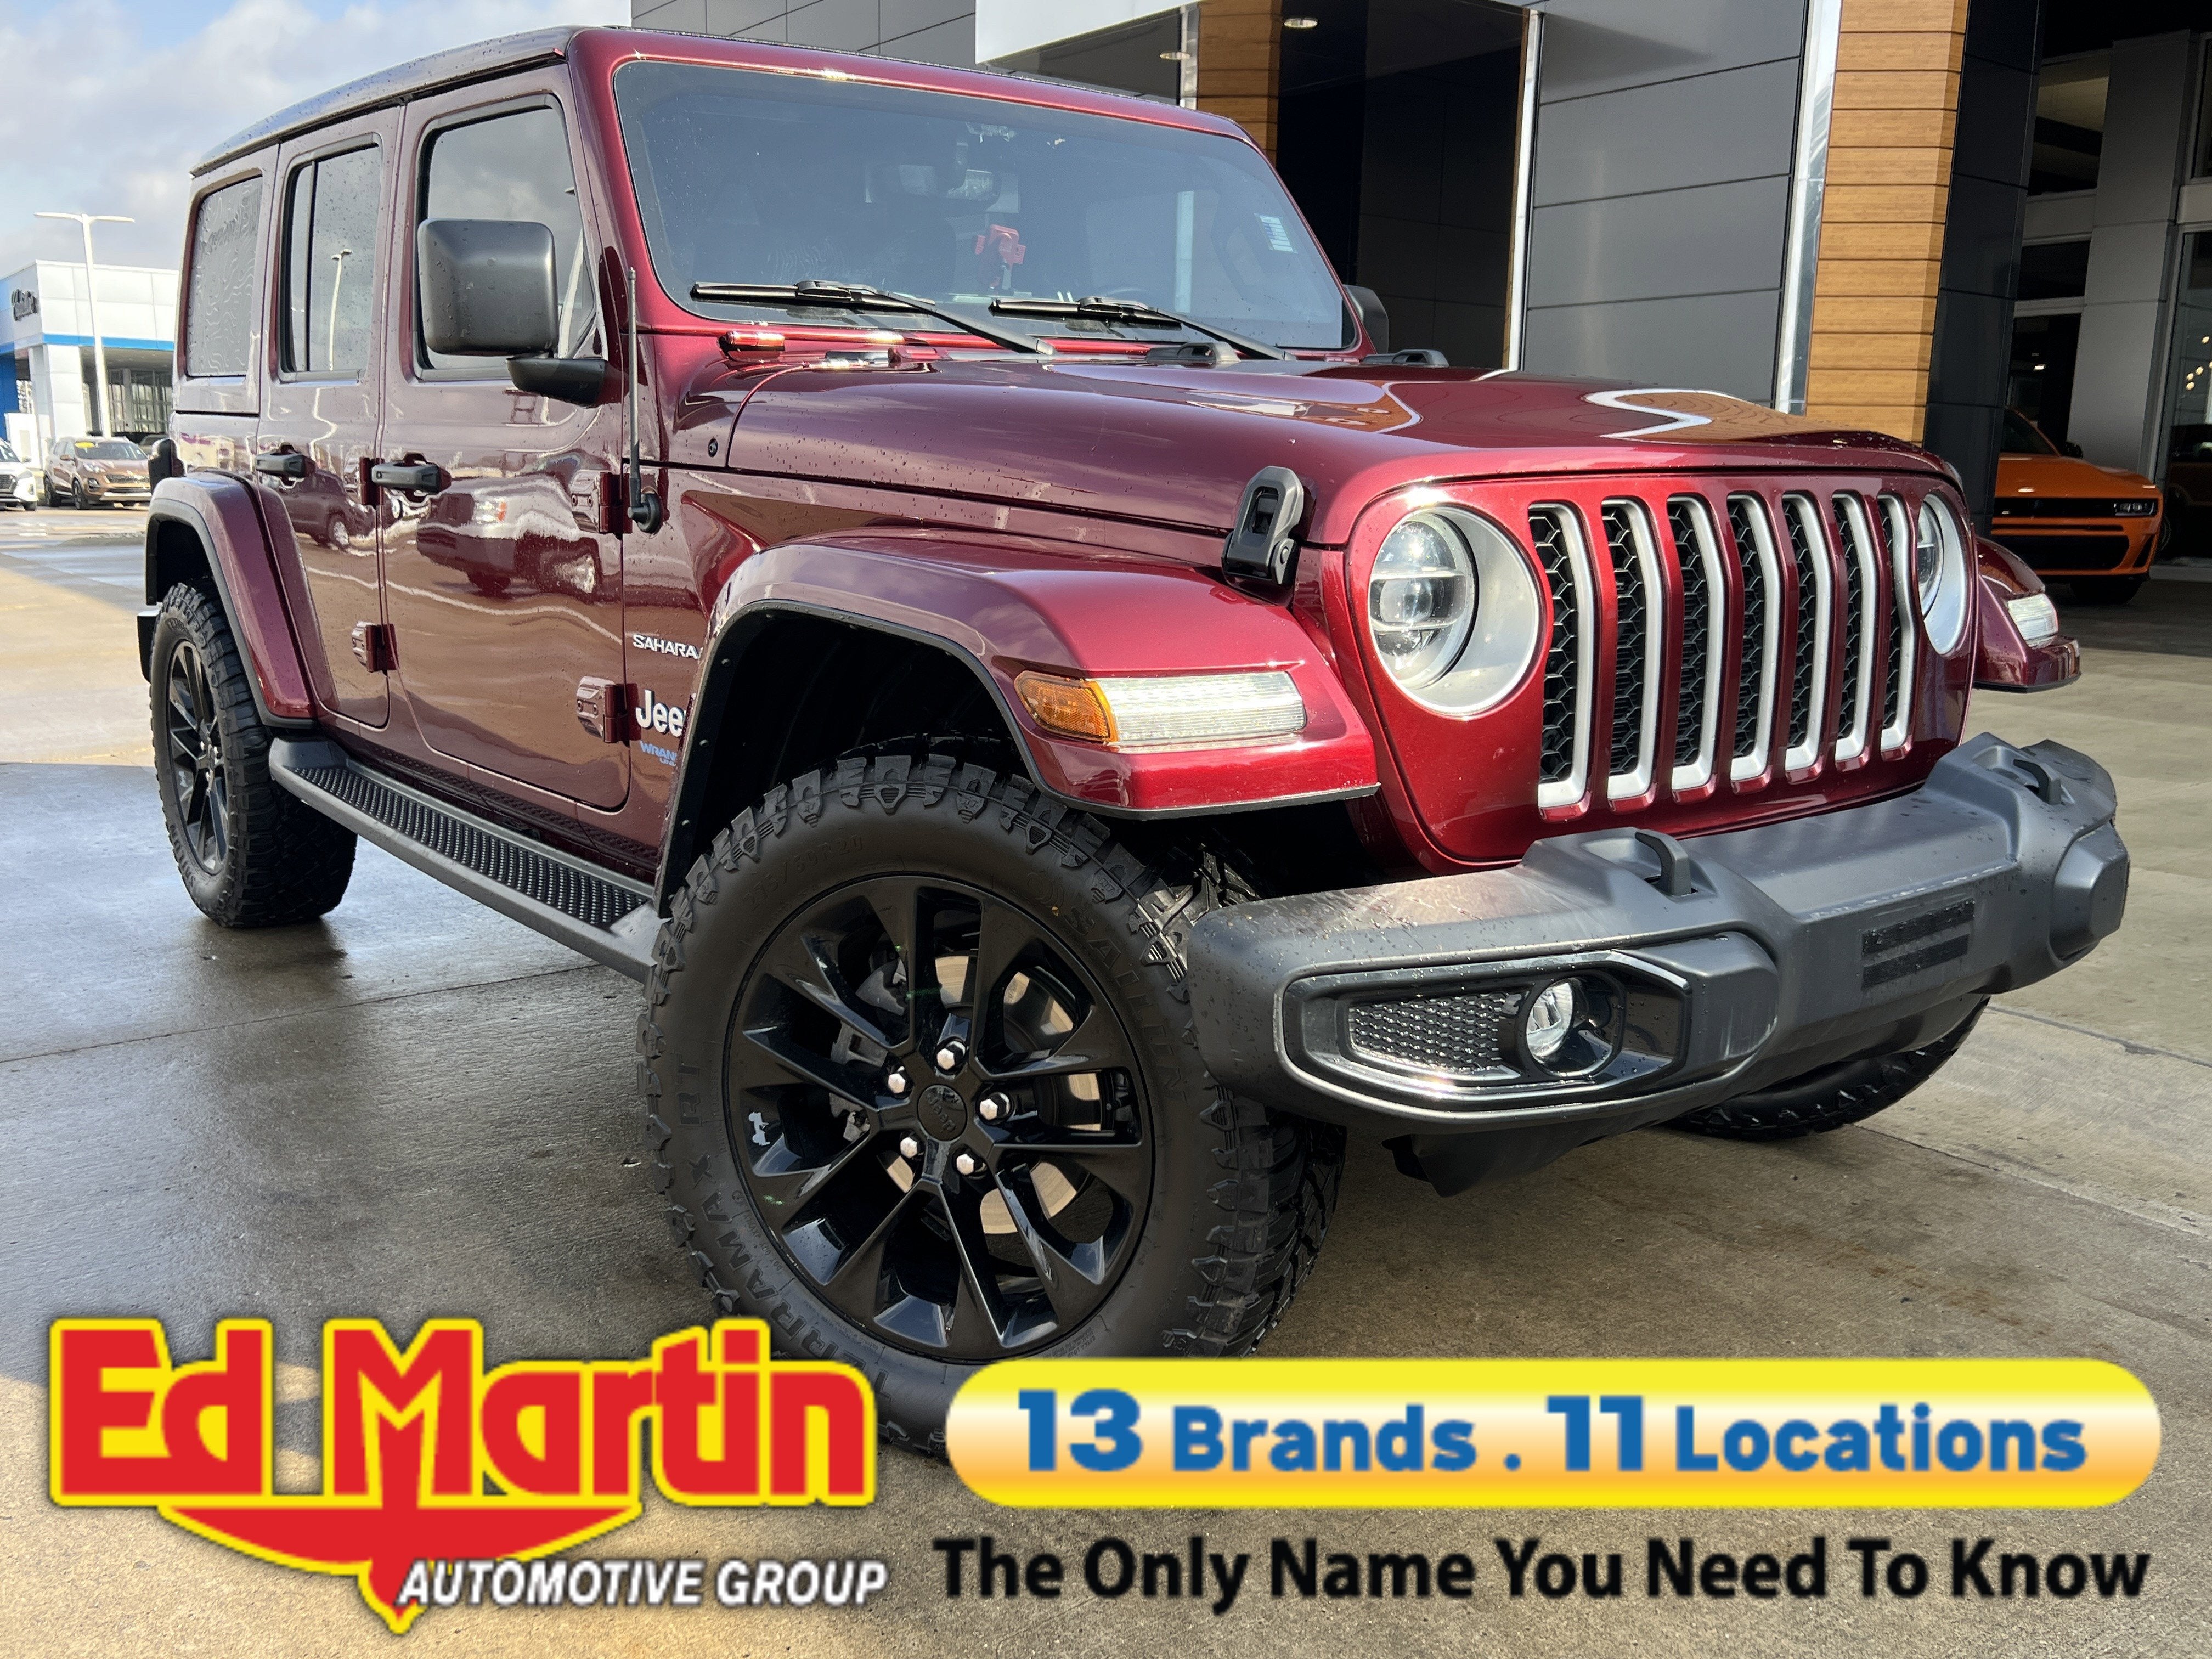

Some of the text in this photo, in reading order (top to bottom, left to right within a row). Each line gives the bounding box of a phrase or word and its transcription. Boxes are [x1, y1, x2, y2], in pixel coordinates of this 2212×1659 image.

[632, 634, 699, 659] SAHARA
[635, 689, 686, 737] Jee
[640, 741, 677, 761] WRAN
[1063, 903, 1188, 1104] SAILUN
